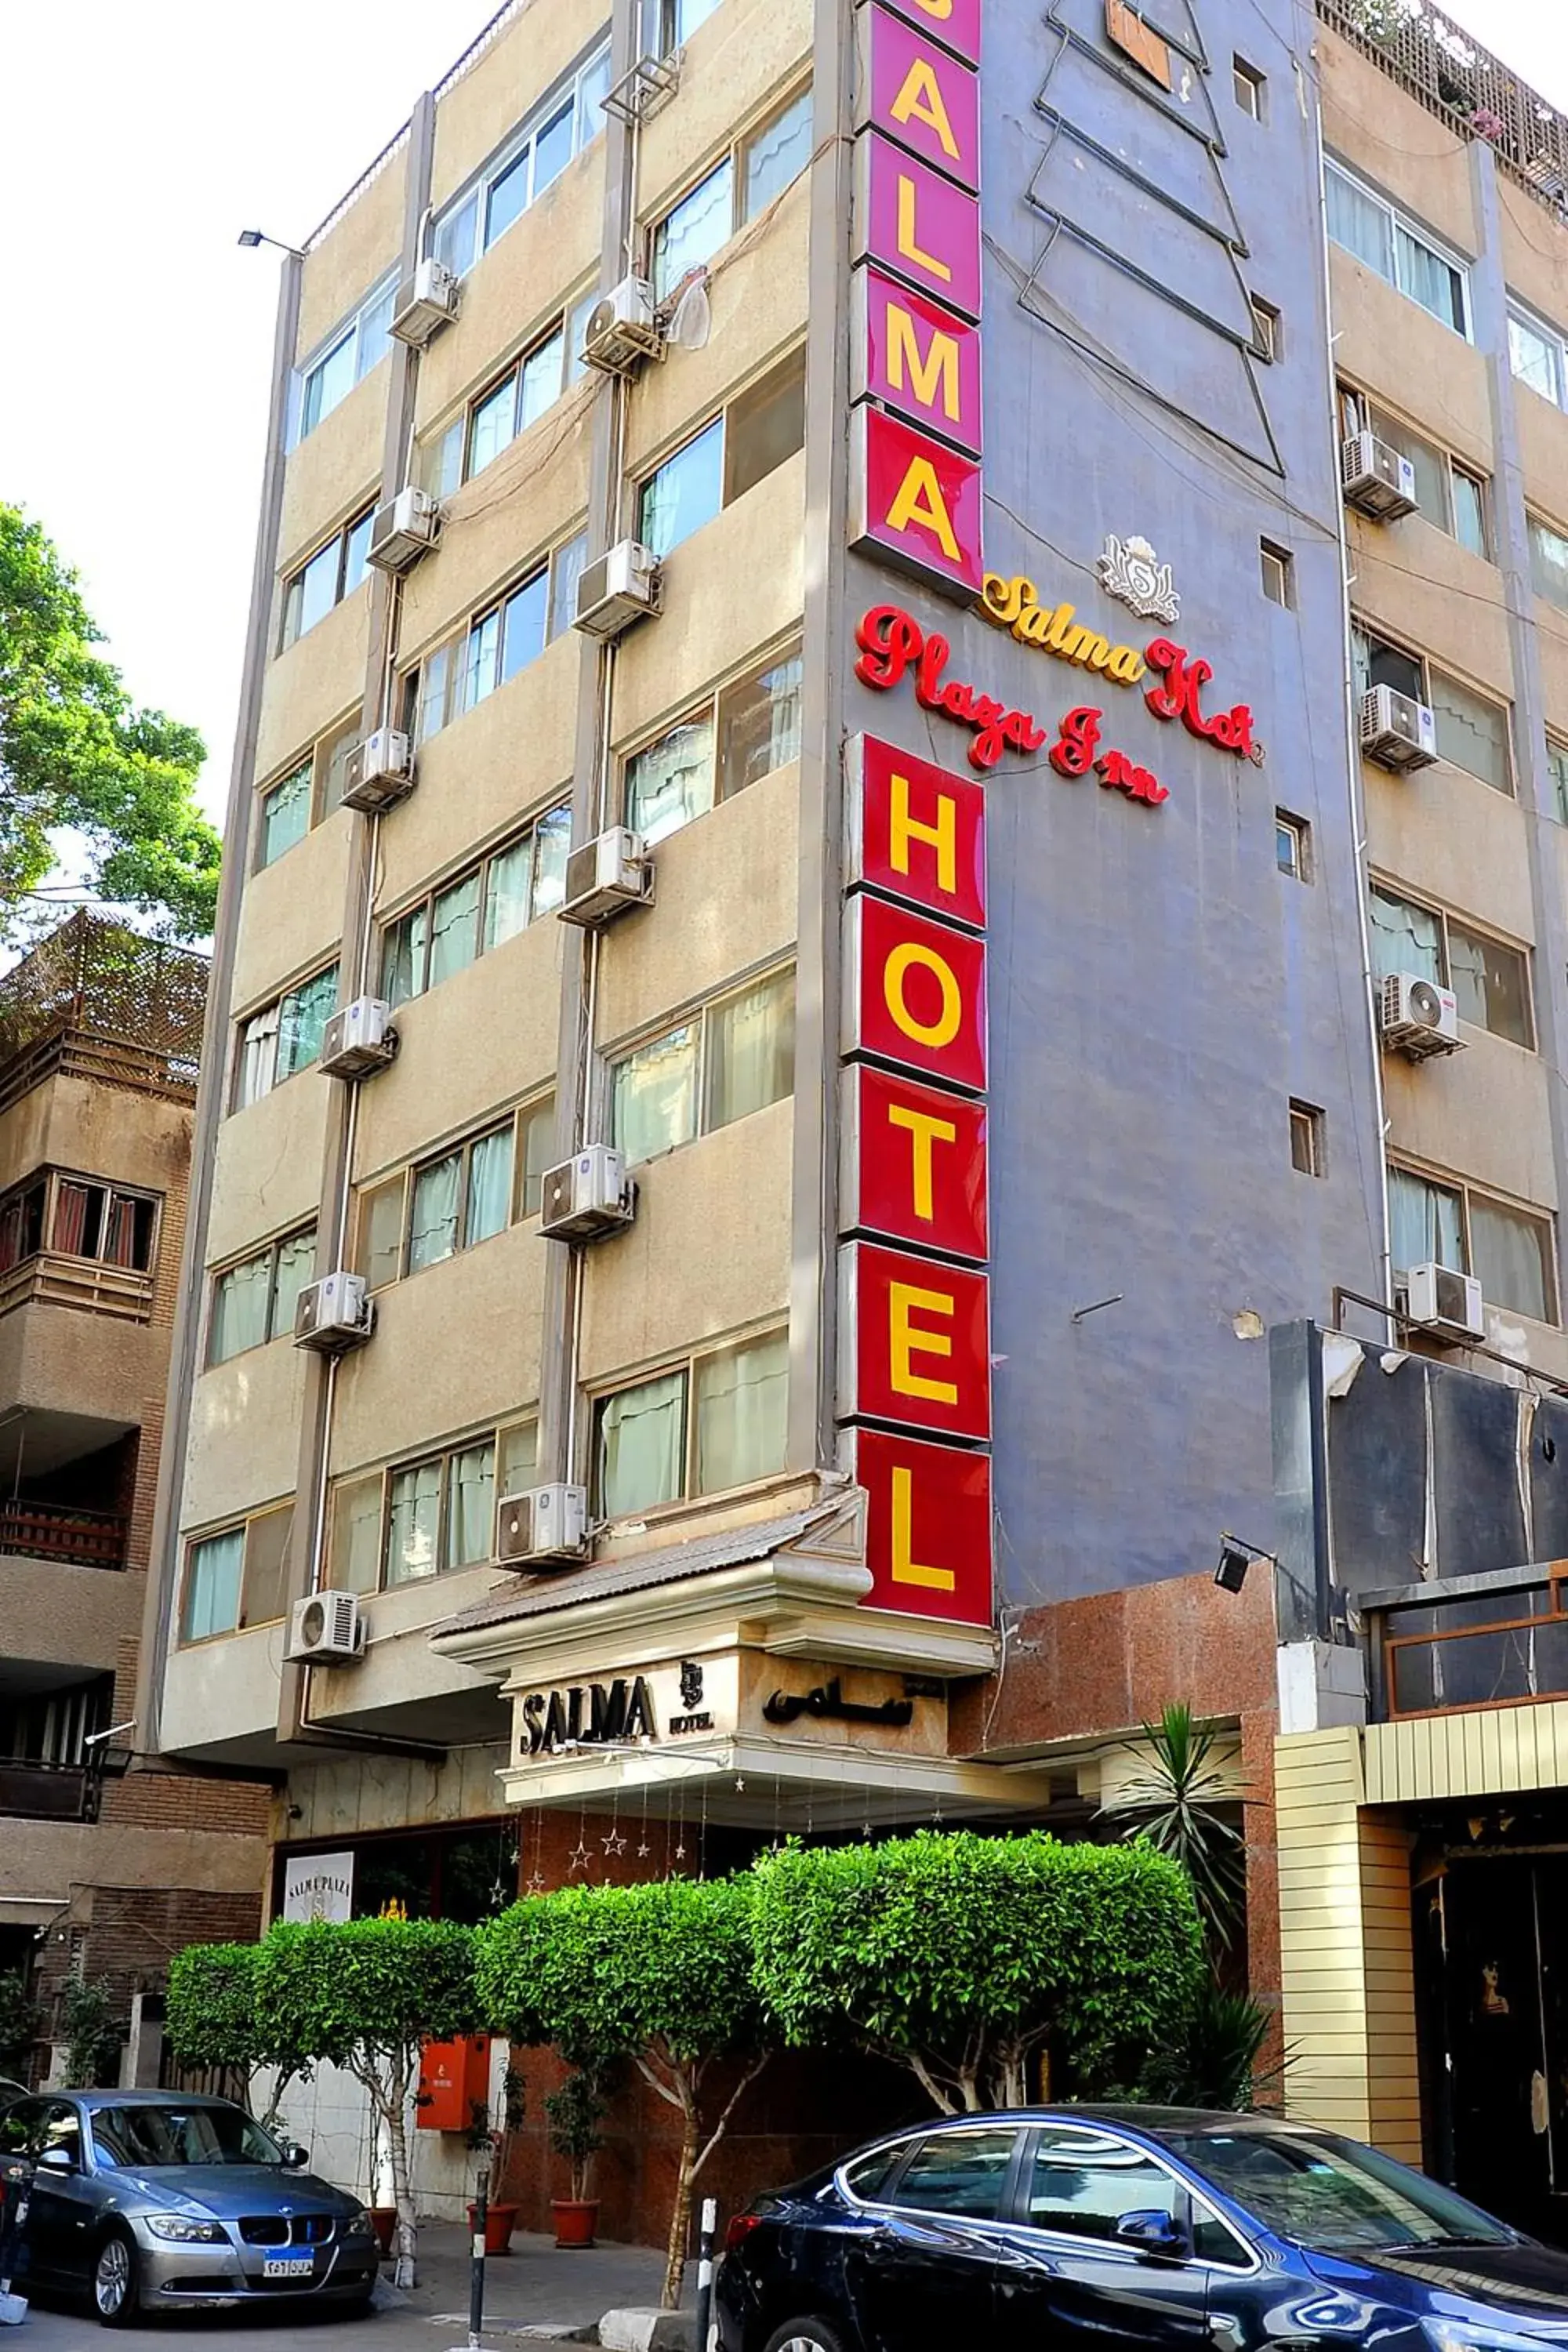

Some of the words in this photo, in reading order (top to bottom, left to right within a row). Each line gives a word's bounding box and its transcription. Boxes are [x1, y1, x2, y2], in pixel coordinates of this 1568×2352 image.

[887, 0, 960, 560] ALMA
[854, 604, 1047, 771] Plaza
[1048, 706, 1171, 808] Inn
[980, 572, 1148, 686] Salma
[884, 774, 960, 1592] HOTEL
[520, 1675, 657, 1755] SALMA
[670, 1712, 715, 1735] HOTEL
